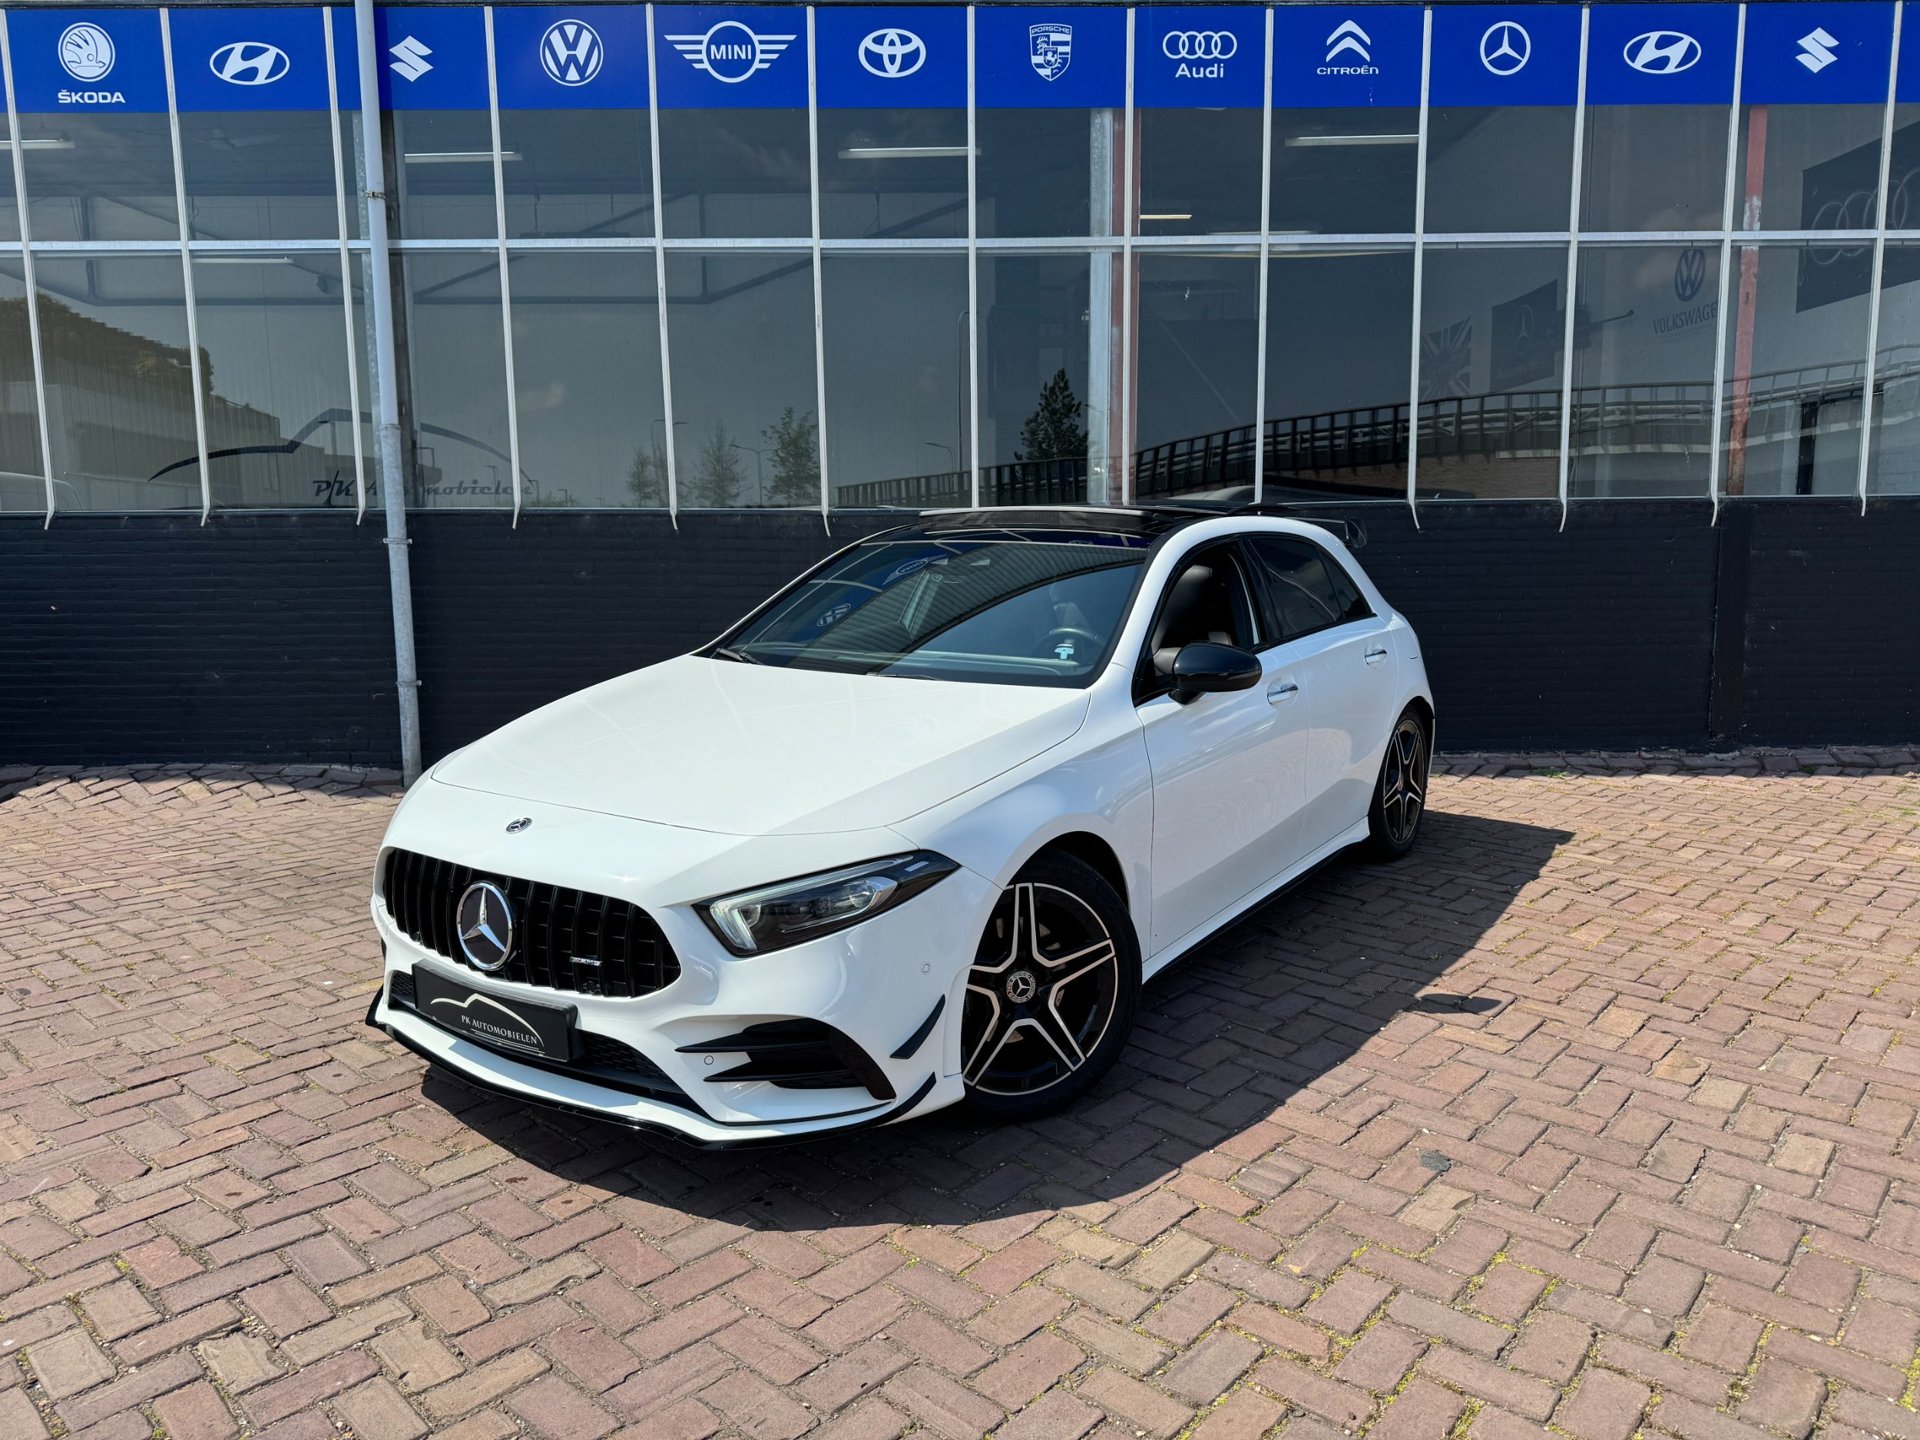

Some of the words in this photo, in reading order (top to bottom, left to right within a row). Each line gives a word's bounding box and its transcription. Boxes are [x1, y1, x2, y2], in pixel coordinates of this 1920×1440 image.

[1031, 26, 1070, 34] PORSCHE
[710, 44, 752, 60] MINI
[1175, 63, 1225, 78] Audi
[1316, 65, 1379, 75] CITROËN
[57, 89, 126, 104] ŠKODA
[1652, 301, 1718, 335] VOLKSWAGE
[460, 1014, 472, 1025] PK
[472, 1017, 538, 1045] AUTOMOBIELEN
